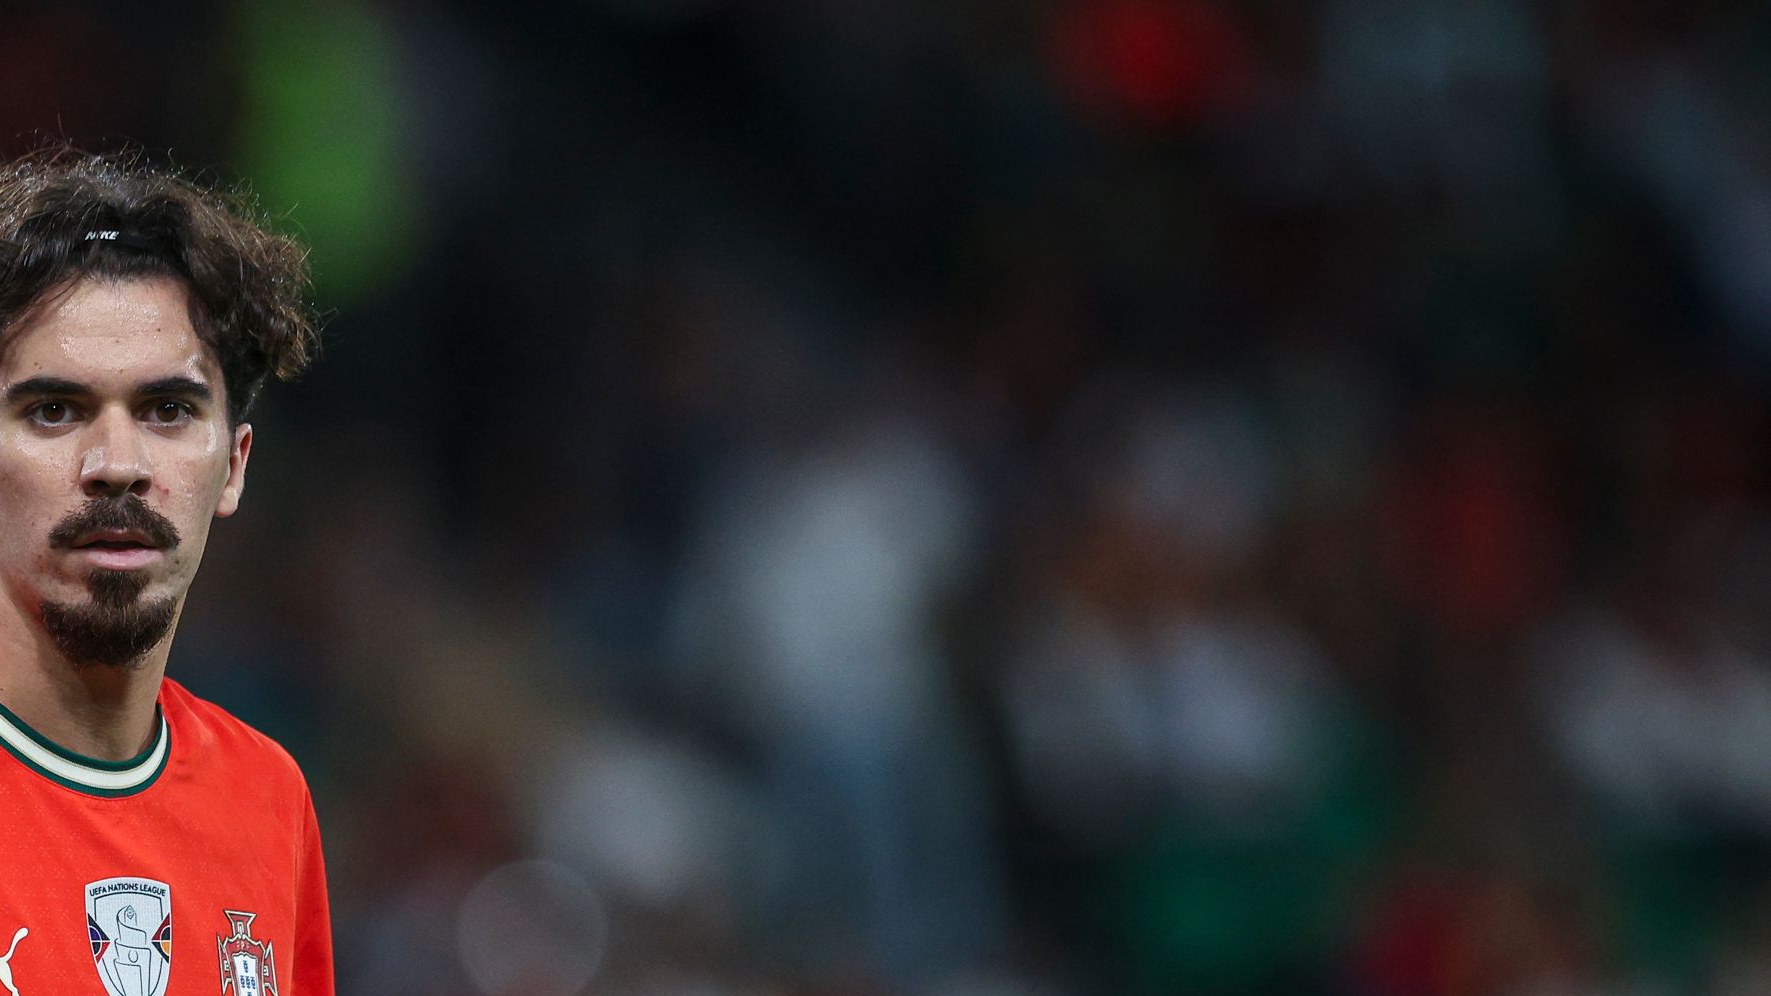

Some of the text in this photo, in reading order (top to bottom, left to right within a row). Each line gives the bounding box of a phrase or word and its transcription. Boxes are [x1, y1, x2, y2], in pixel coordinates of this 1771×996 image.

[89, 883, 166, 896] UEFA NATIONS LEAGUE
